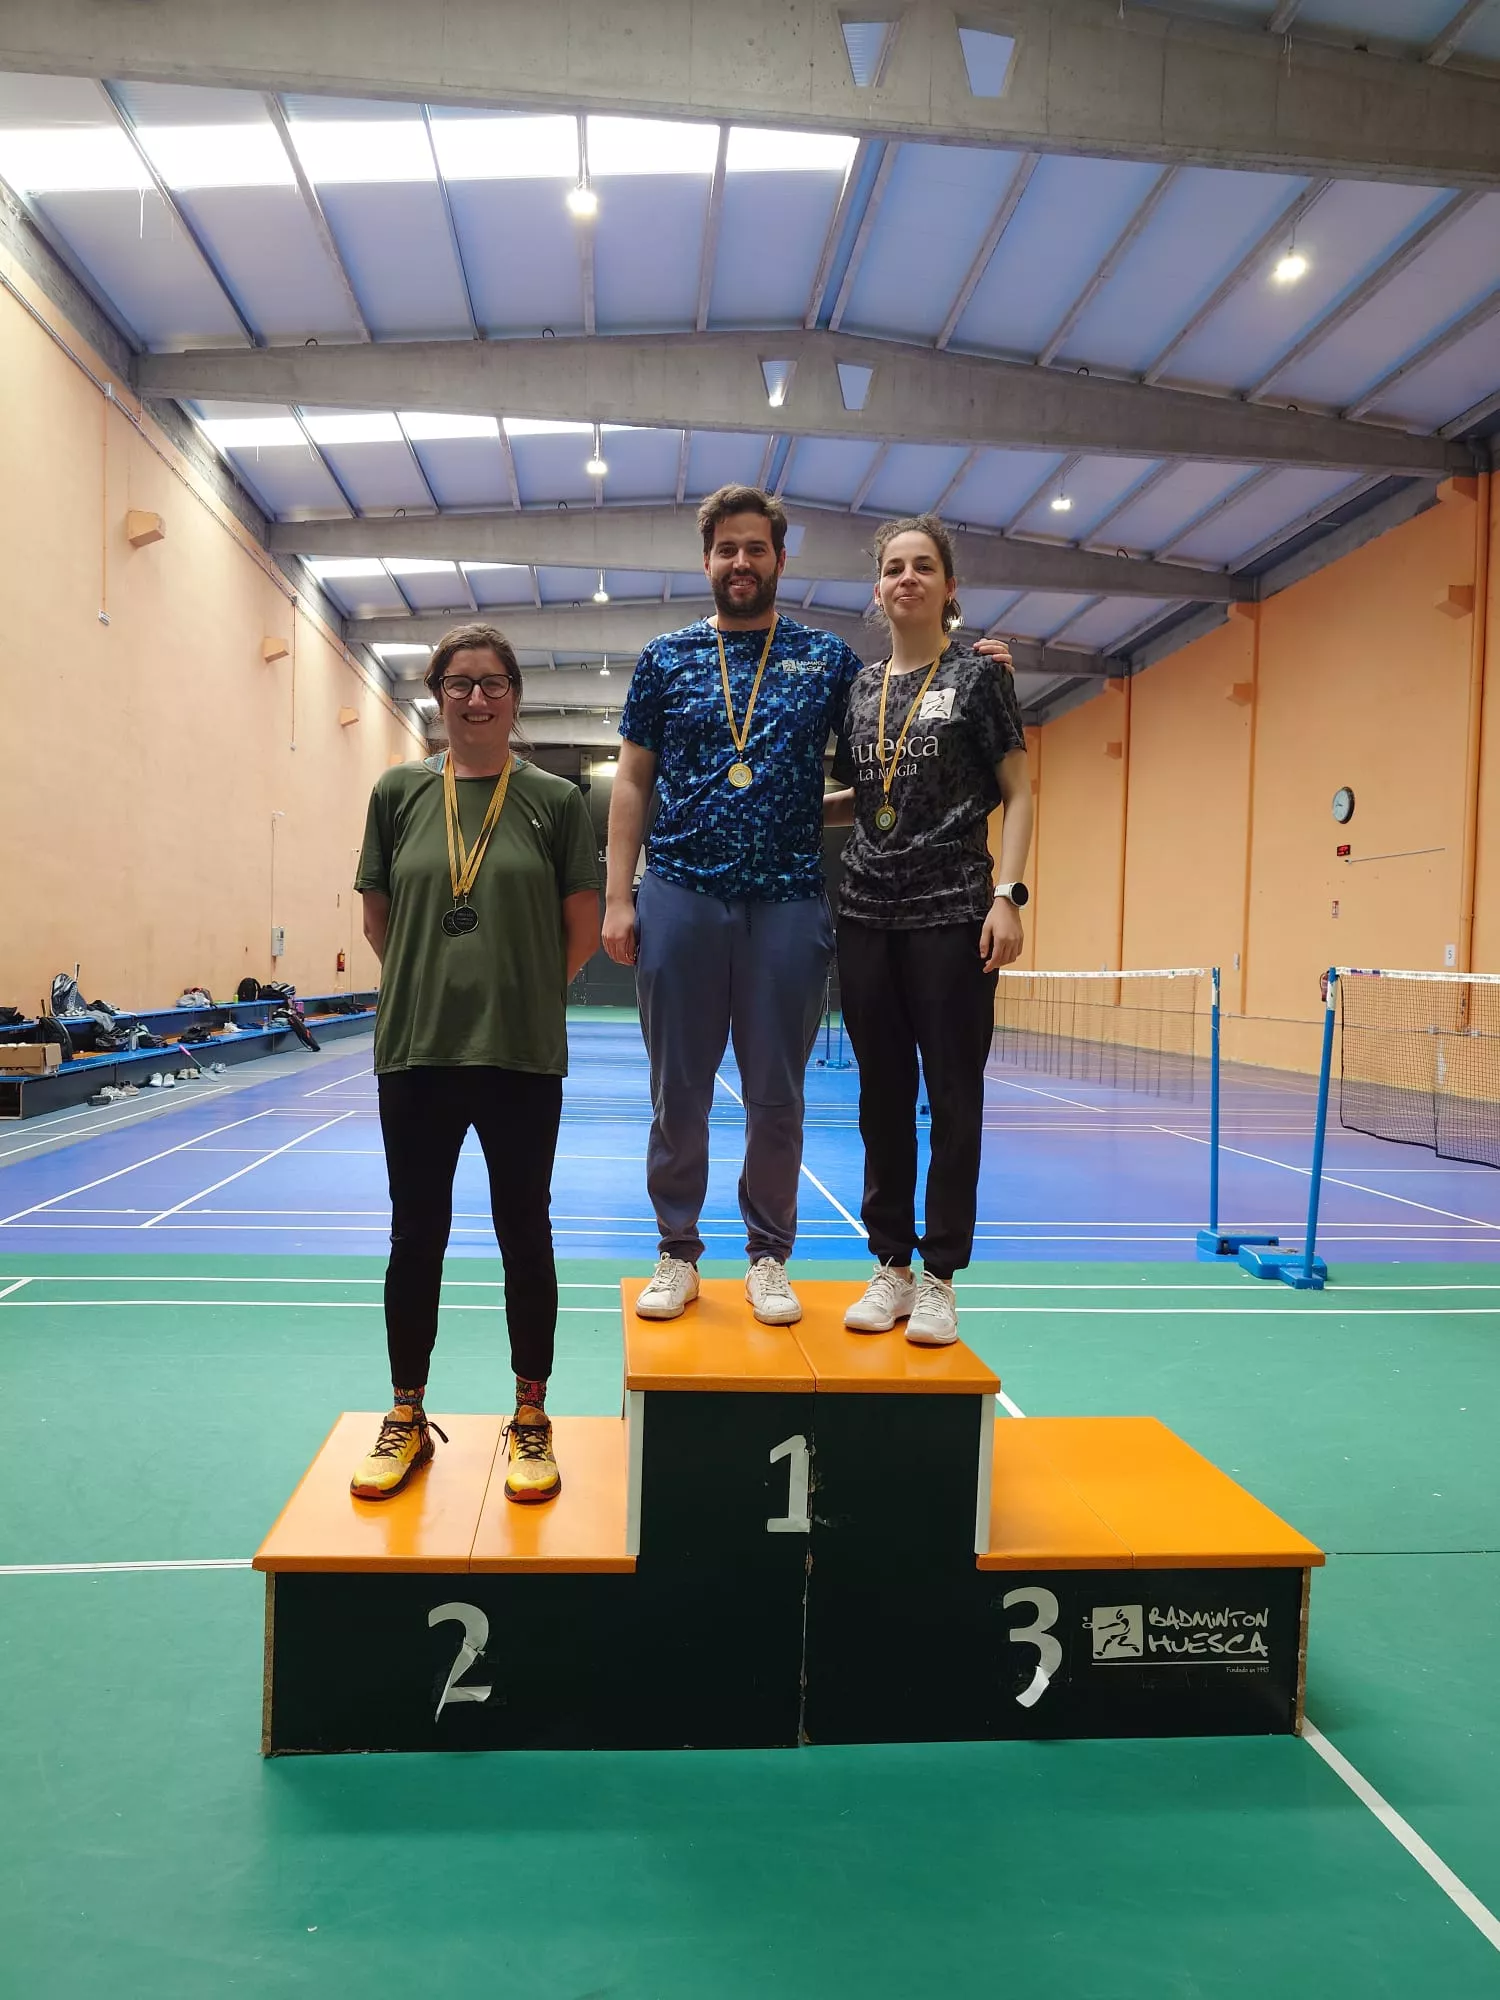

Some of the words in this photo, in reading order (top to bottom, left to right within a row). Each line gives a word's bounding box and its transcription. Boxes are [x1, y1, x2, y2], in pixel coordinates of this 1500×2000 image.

[767, 1435, 811, 1533] 1
[428, 1602, 492, 1723] 2
[1003, 1586, 1062, 1707] 3
[1149, 1631, 1269, 1657] HUESCA
